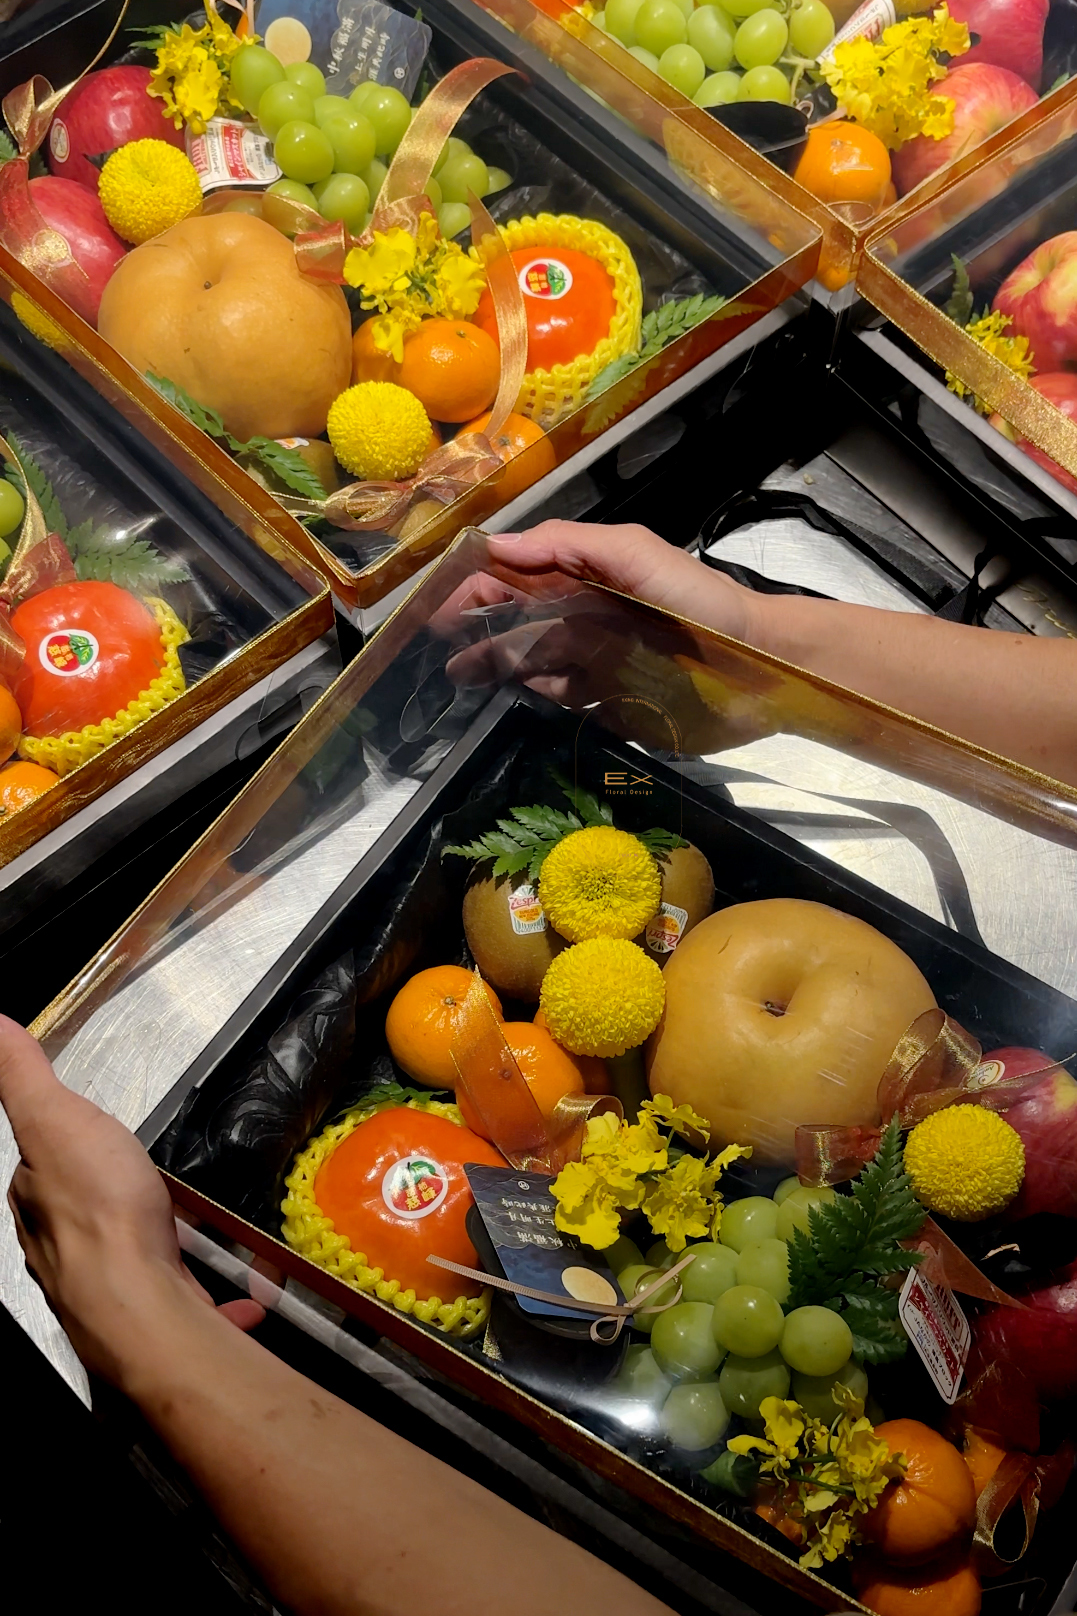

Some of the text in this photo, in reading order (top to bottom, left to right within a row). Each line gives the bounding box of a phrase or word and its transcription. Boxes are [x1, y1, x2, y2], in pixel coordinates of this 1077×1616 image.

[327, 16, 355, 74] 中秋福滿
[509, 895, 540, 910] Zespr
[501, 1197, 554, 1213] 涯共此時
[517, 1231, 578, 1250] 中秋福滿
